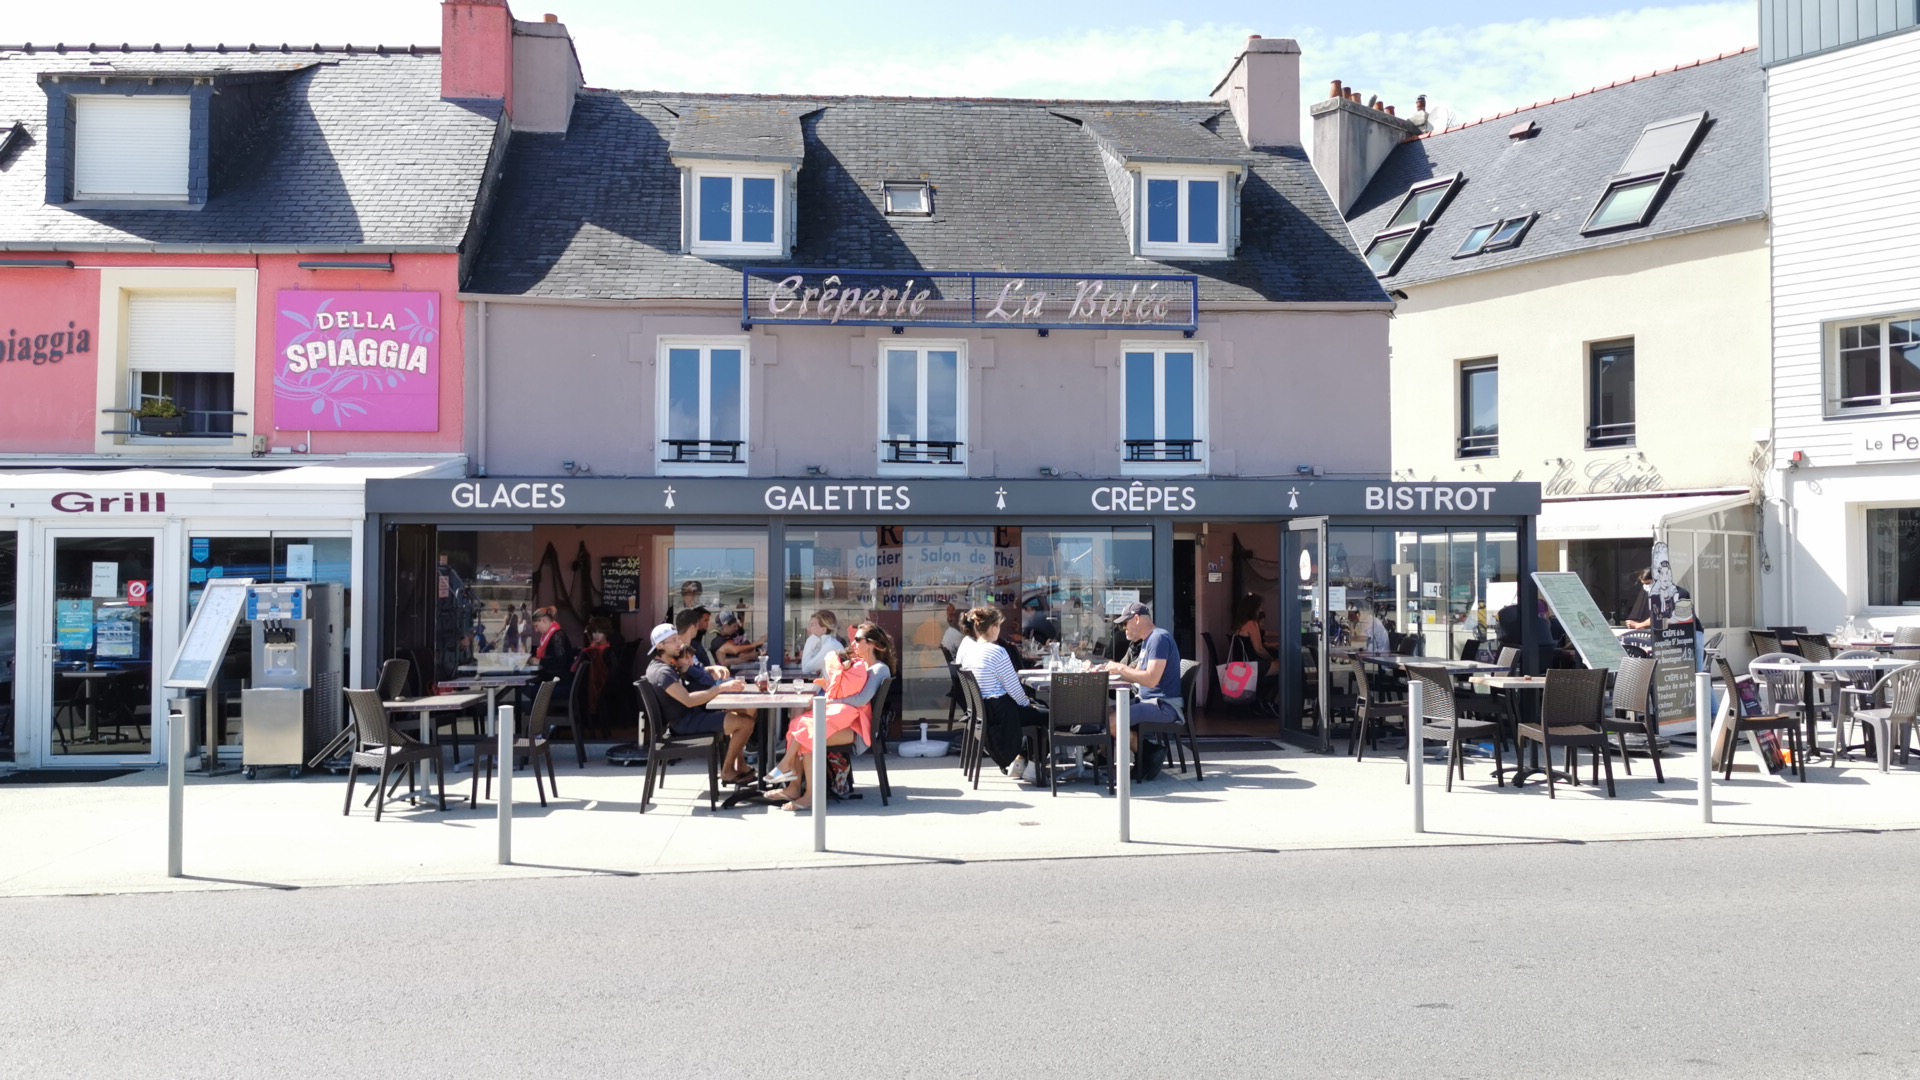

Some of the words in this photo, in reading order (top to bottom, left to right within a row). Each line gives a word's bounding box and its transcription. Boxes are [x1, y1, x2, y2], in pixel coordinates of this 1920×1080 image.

[768, 274, 931, 324] Crêperie
[985, 278, 1047, 321] La
[1067, 278, 1173, 320] Bolée
[316, 310, 397, 331] DELLA
[286, 338, 429, 375] SPIAGGIA
[1865, 438, 1884, 451] Le
[1891, 433, 1920, 451] Pe
[50, 491, 166, 513] Grill
[451, 482, 566, 508] GLACES
[764, 485, 911, 511] GALETTES
[1091, 481, 1196, 511] CRÊPES
[1365, 486, 1496, 511] BISTROT
[855, 550, 901, 569] Glacier
[921, 547, 960, 563] Salon
[969, 550, 986, 564] de
[994, 551, 1015, 569] Thé
[876, 577, 913, 588] Salles
[883, 591, 957, 606] panoramique
